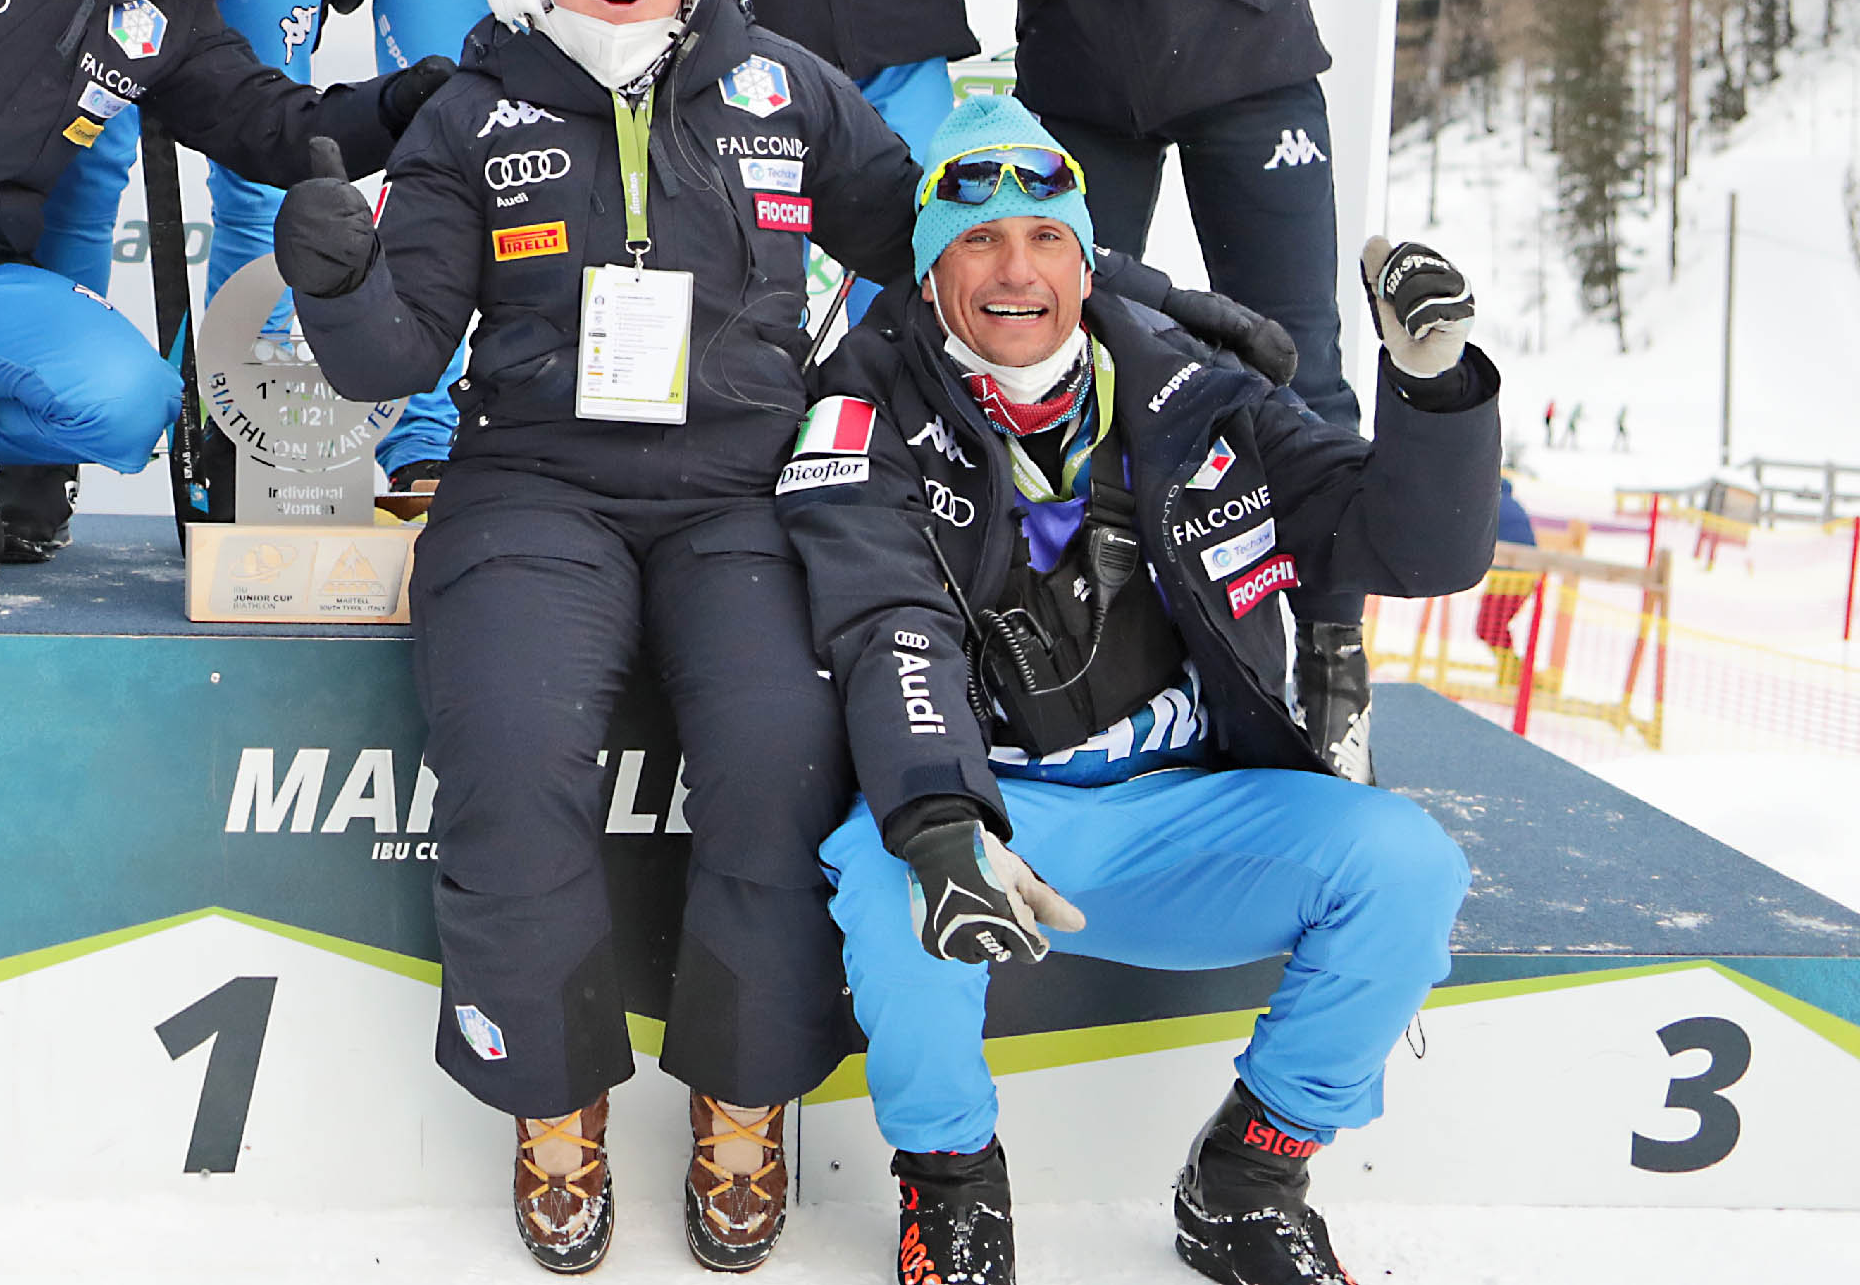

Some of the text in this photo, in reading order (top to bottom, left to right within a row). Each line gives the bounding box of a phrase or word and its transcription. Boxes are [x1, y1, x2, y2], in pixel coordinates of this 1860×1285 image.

[496, 192, 529, 208] Audi
[757, 200, 810, 225] FIOCCHI
[499, 229, 559, 255] PIRELLI
[1147, 360, 1202, 413] Kappa
[208, 372, 308, 460] BIATHLON
[781, 460, 864, 485] Dicoflor
[268, 486, 344, 500] Individual
[277, 501, 335, 515] Women
[1172, 484, 1272, 546] FALCONE
[233, 594, 293, 602] JUNIOR CUP
[1229, 560, 1295, 611] FIOCCHI
[892, 650, 947, 735] Audi
[371, 841, 410, 861] IBU
[154, 976, 279, 1175] 1
[1630, 1015, 1754, 1173] 3
